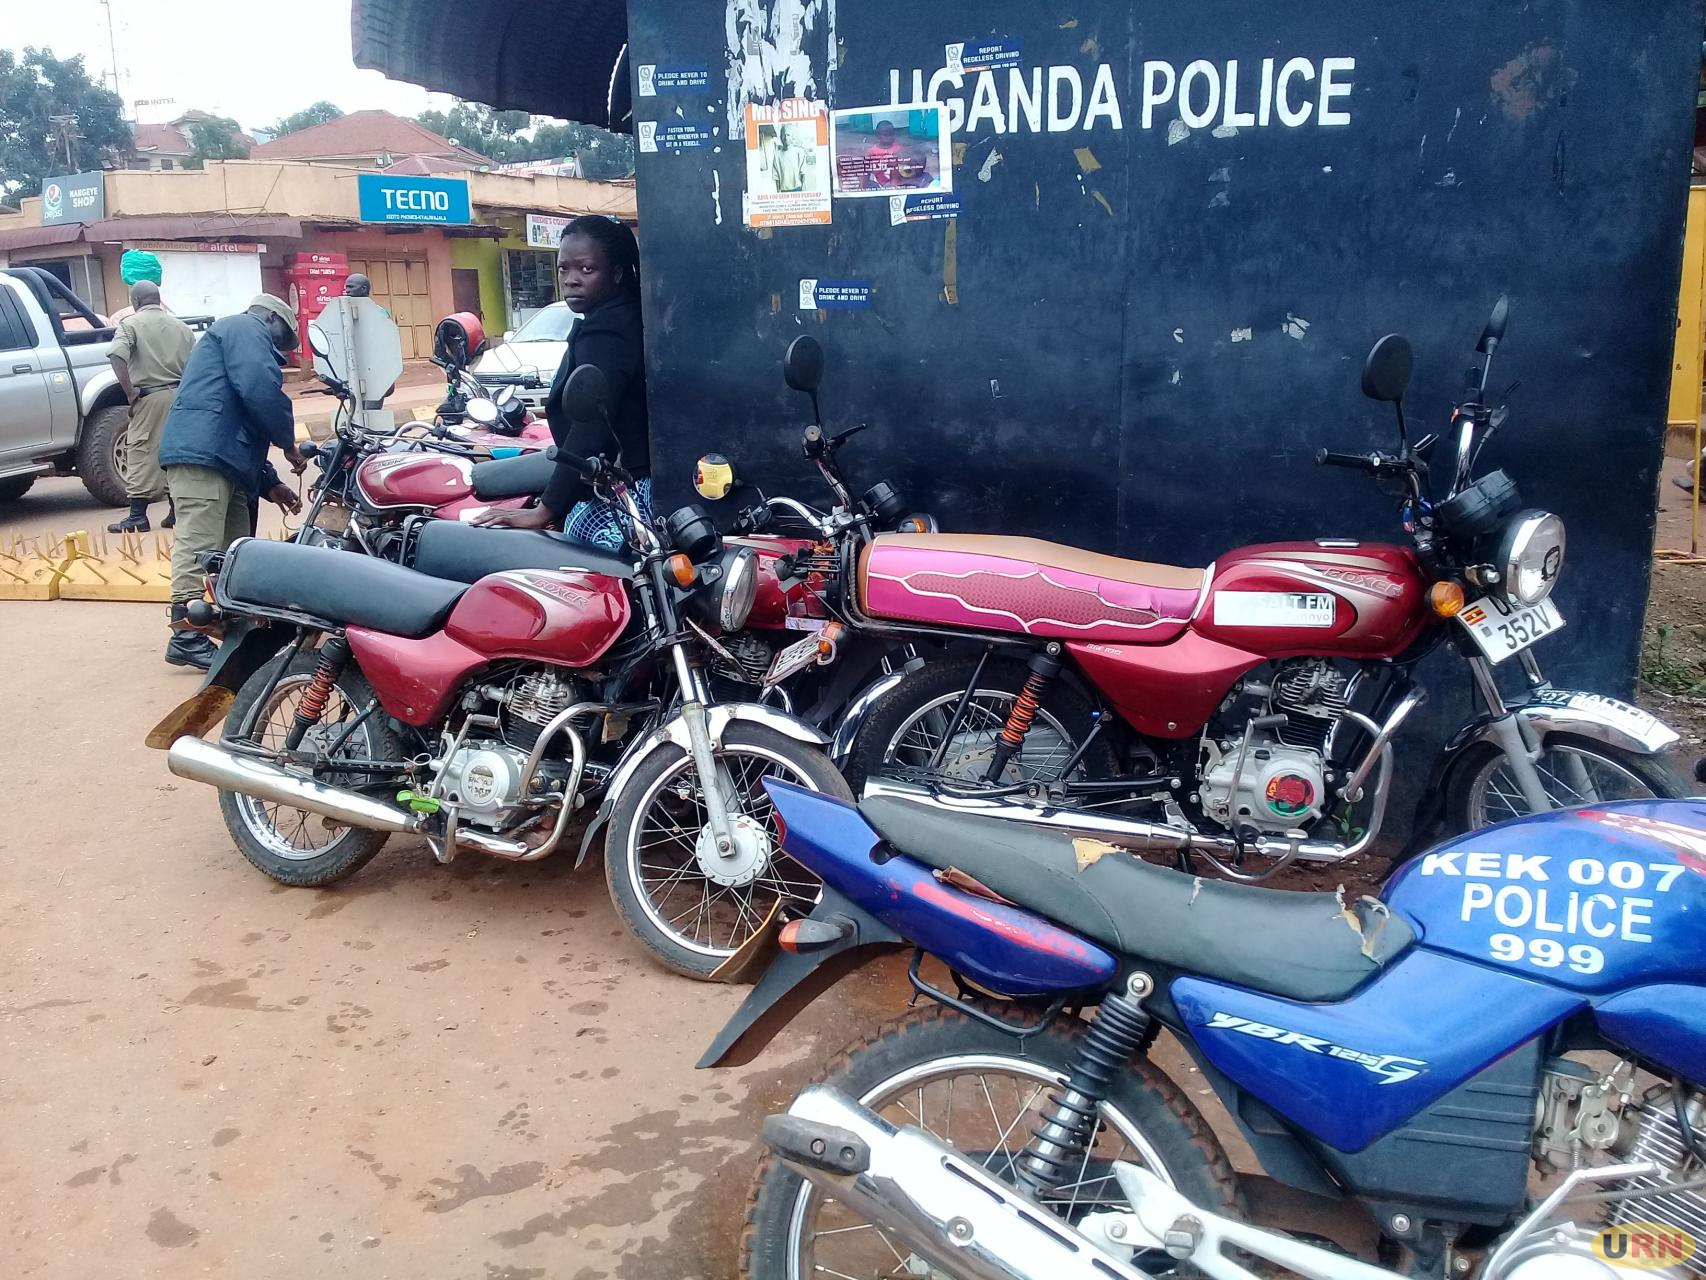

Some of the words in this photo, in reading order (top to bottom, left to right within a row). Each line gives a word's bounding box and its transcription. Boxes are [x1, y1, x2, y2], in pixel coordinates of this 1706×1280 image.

[963, 54, 994, 64] RECKLESS
[995, 51, 1020, 60] DRIVING
[978, 45, 1003, 54] REPORT
[680, 71, 699, 79] NEVER
[1142, 57, 1355, 128] POLICE
[72, 196, 96, 208] SHOP
[380, 188, 449, 211] TECNO
[935, 202, 960, 210] DRIVING
[44, 208, 63, 220] pepsi
[210, 242, 239, 252] airtel
[1322, 567, 1405, 598] BOXER
[532, 578, 588, 608] BOXER
[1305, 596, 1330, 610] FM
[1497, 605, 1552, 649] 352V
[1420, 852, 1553, 882] KEK
[1567, 858, 1687, 893] 007
[1460, 882, 1655, 944] POLICE
[1489, 932, 1606, 975] 999
